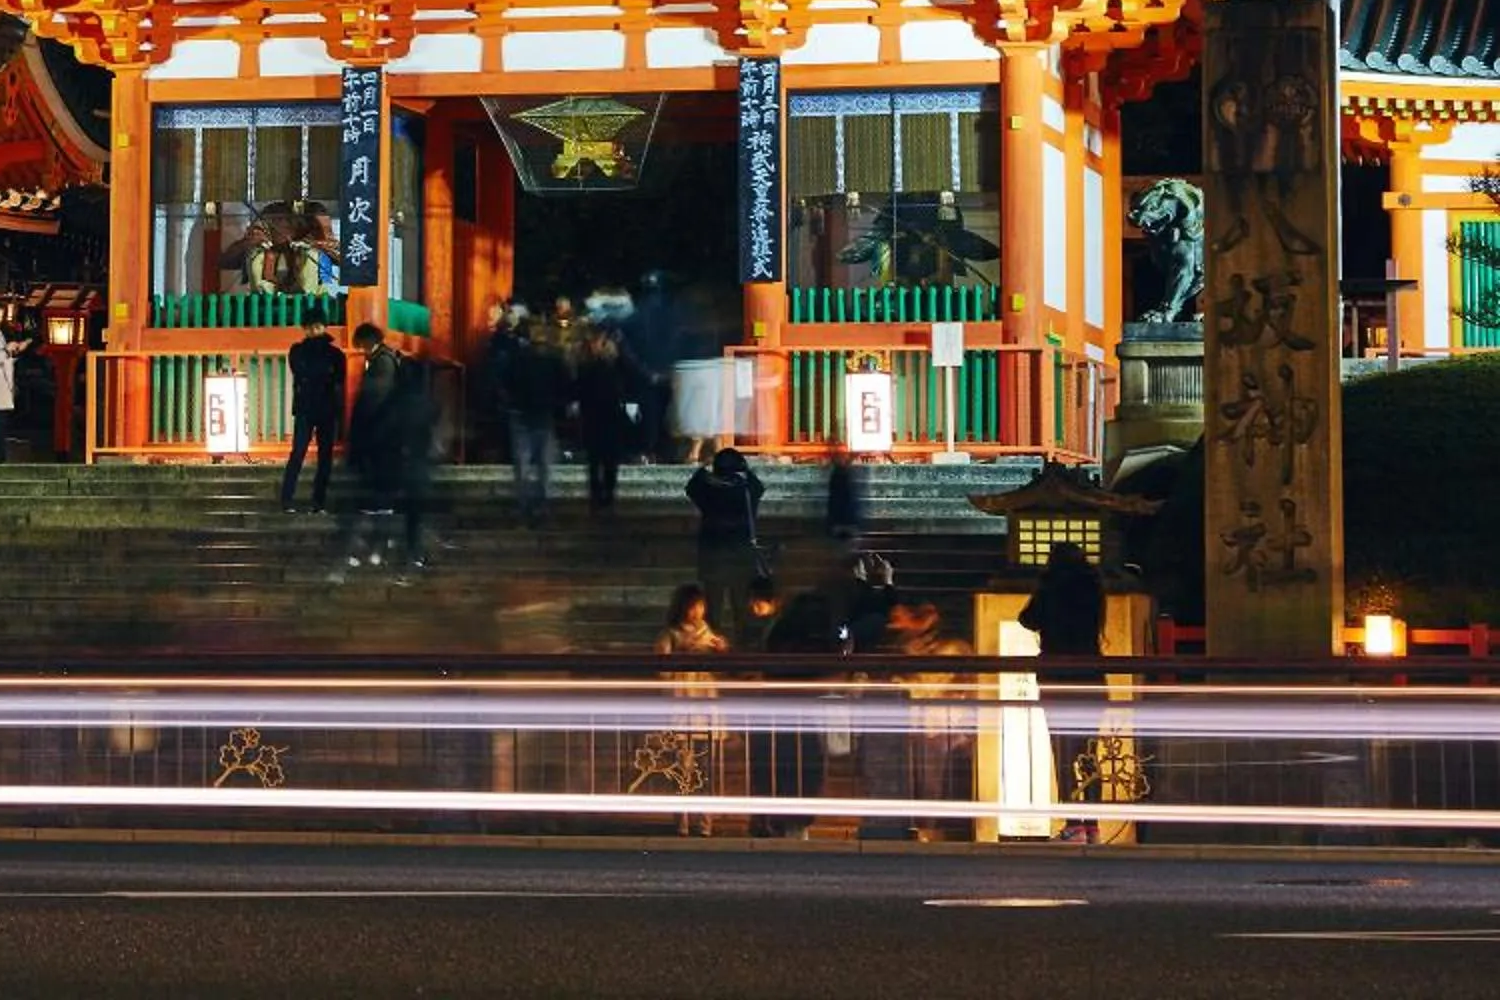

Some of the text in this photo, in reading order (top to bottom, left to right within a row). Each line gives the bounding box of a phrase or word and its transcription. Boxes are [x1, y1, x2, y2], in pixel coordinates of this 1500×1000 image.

[342, 69, 361, 144] 午前十時
[361, 71, 379, 134] 四月一日
[346, 155, 373, 267] 月次祭
[1211, 195, 1323, 592] 八坂神社
